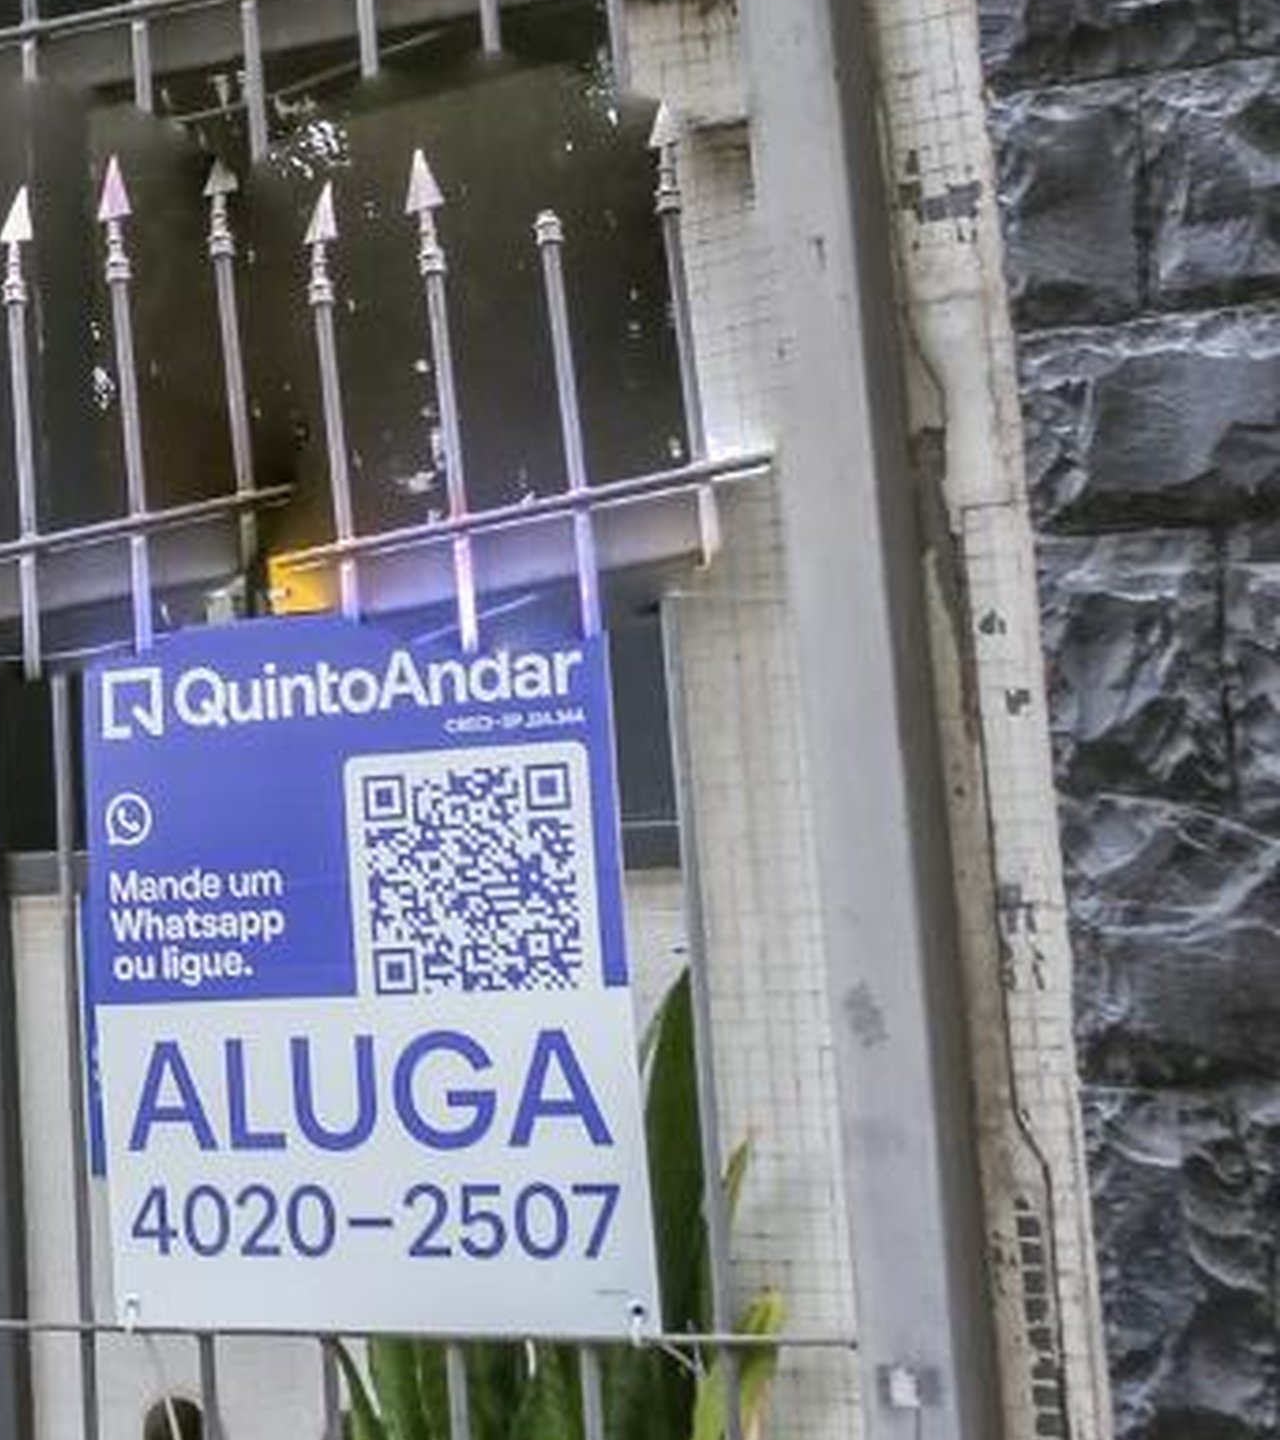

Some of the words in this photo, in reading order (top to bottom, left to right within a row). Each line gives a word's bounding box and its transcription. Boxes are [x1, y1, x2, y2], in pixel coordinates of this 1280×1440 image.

[173, 649, 584, 727] QuintoAndar
[108, 867, 222, 905] Mande
[228, 868, 284, 898] um
[108, 907, 286, 943] Whatsapp
[112, 954, 156, 981] ou
[161, 945, 254, 987] ligue.
[127, 1027, 615, 1154] ALUGA
[130, 1180, 622, 1260] 4020-2507
